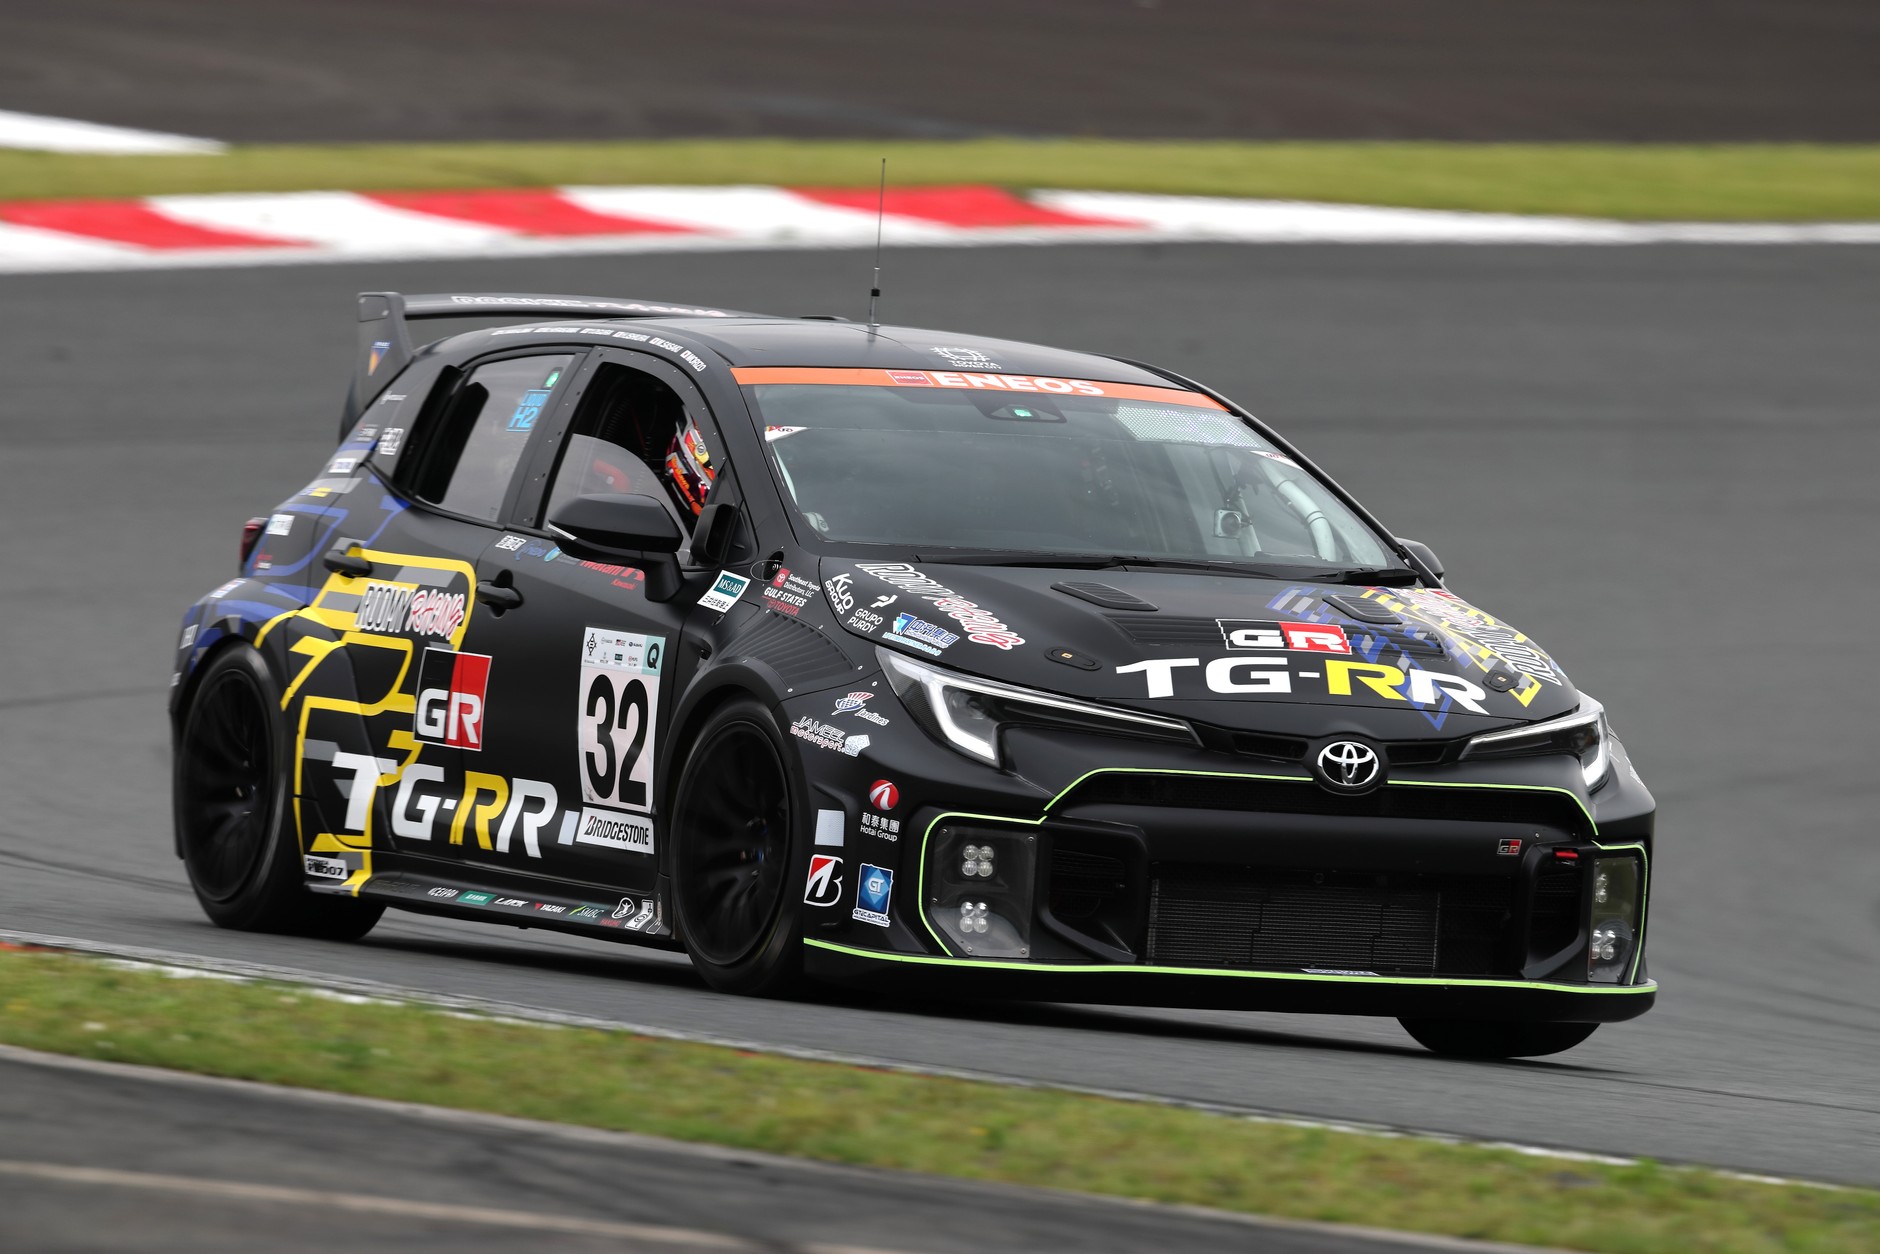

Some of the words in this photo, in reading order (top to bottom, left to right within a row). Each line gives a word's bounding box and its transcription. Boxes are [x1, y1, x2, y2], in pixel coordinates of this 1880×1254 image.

[930, 371, 1104, 395] ENEOS
[511, 407, 539, 428] H2
[718, 579, 742, 594] MS&AD
[764, 587, 783, 600] GULF
[783, 590, 807, 607] STATES
[774, 600, 801, 616] TOYOTA
[825, 580, 845, 615] GROUP
[847, 616, 877, 633] PURDY
[854, 608, 884, 626] GRUPO
[1229, 629, 1347, 652] GR
[646, 642, 660, 670] Q
[1116, 657, 1490, 716] TG-RR
[416, 688, 482, 744] GR
[585, 673, 649, 807] 32
[332, 751, 558, 859] TG-RR
[584, 815, 650, 846] BRIDGESTONE
[861, 812, 900, 833] 和泰集團
[860, 825, 877, 837] Hotai
[877, 830, 898, 842] Group
[1499, 845, 1520, 853] GR
[868, 877, 885, 893] GT
